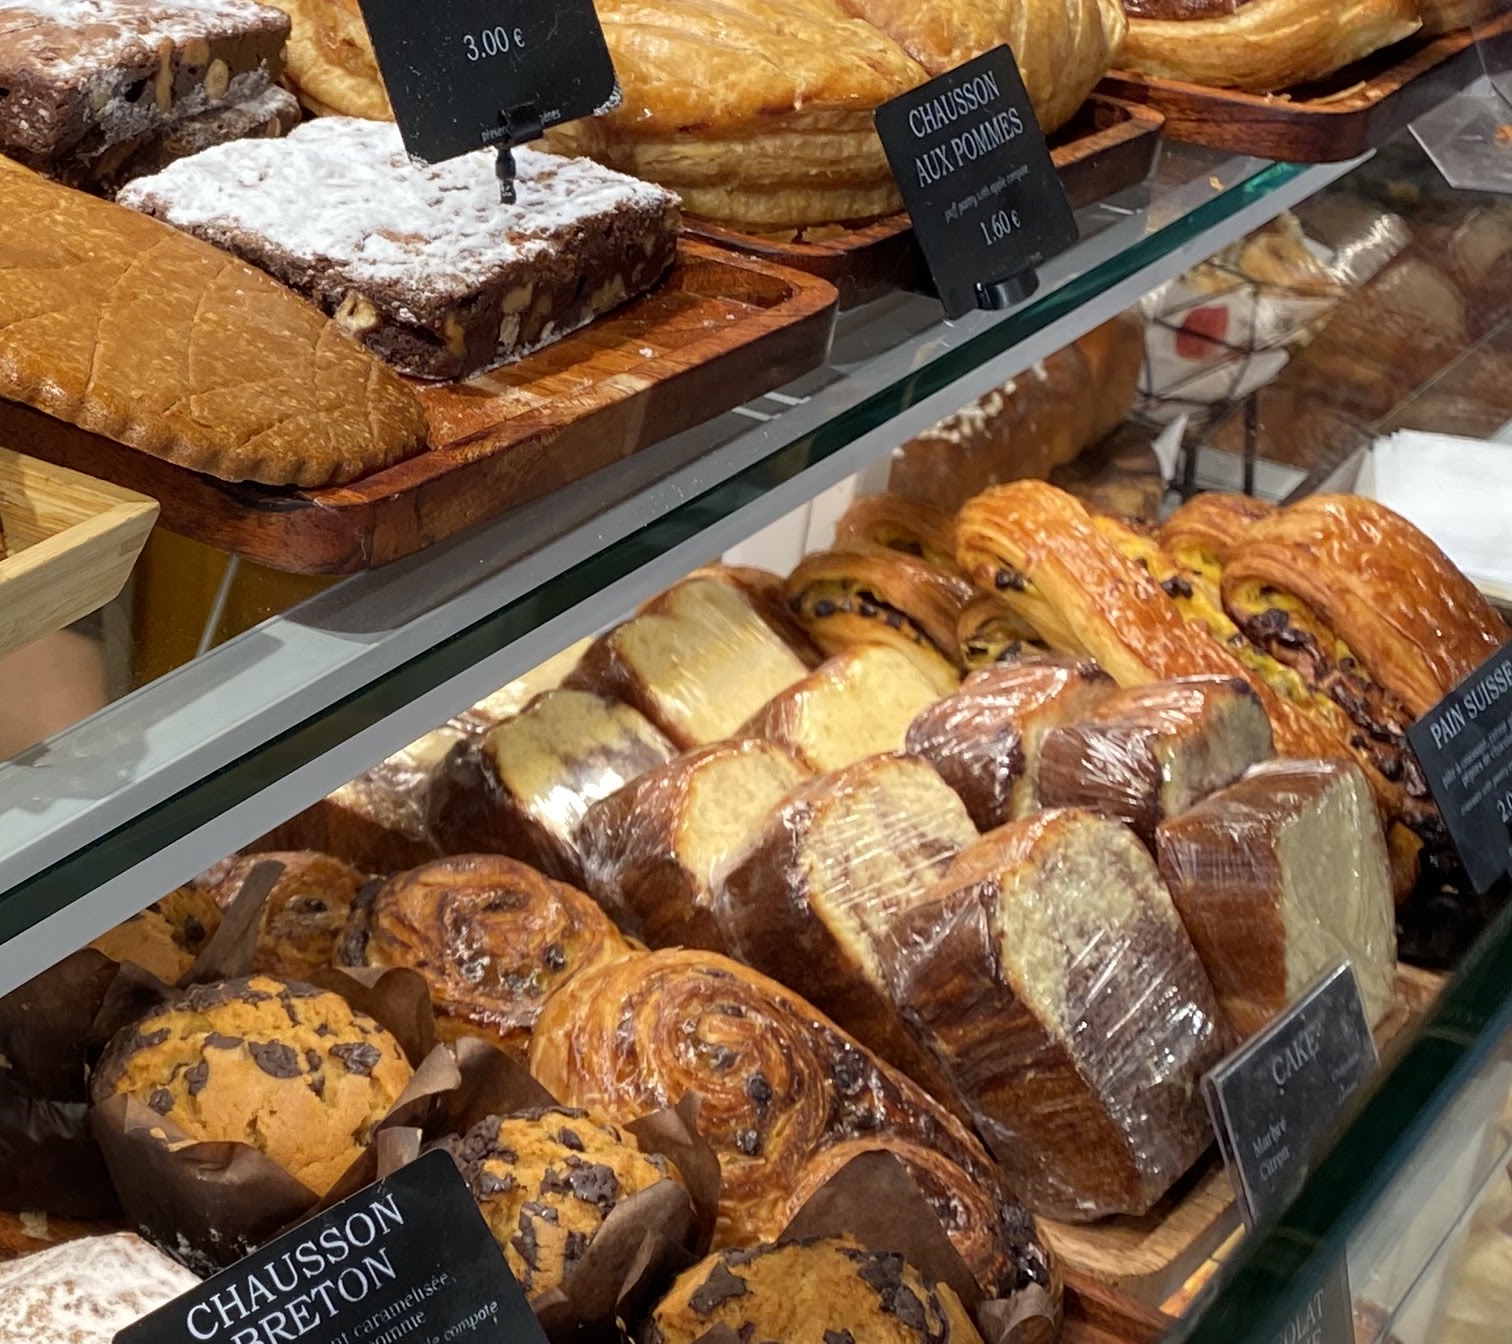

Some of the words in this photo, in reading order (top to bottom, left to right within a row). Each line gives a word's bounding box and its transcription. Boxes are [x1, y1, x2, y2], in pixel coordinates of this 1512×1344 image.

[463, 26, 509, 61] 3.00
[513, 28, 526, 48] €
[908, 70, 1001, 138] CHAUSSON
[915, 144, 955, 188] AUX
[950, 107, 1024, 167] POMMES
[980, 210, 1011, 246] 1.60
[1011, 210, 1021, 228] €
[1430, 703, 1466, 750] PAIN
[1463, 660, 1512, 719] SUISSE
[186, 1192, 405, 1342] CHAUSSON
[442, 1299, 500, 1344] compote
